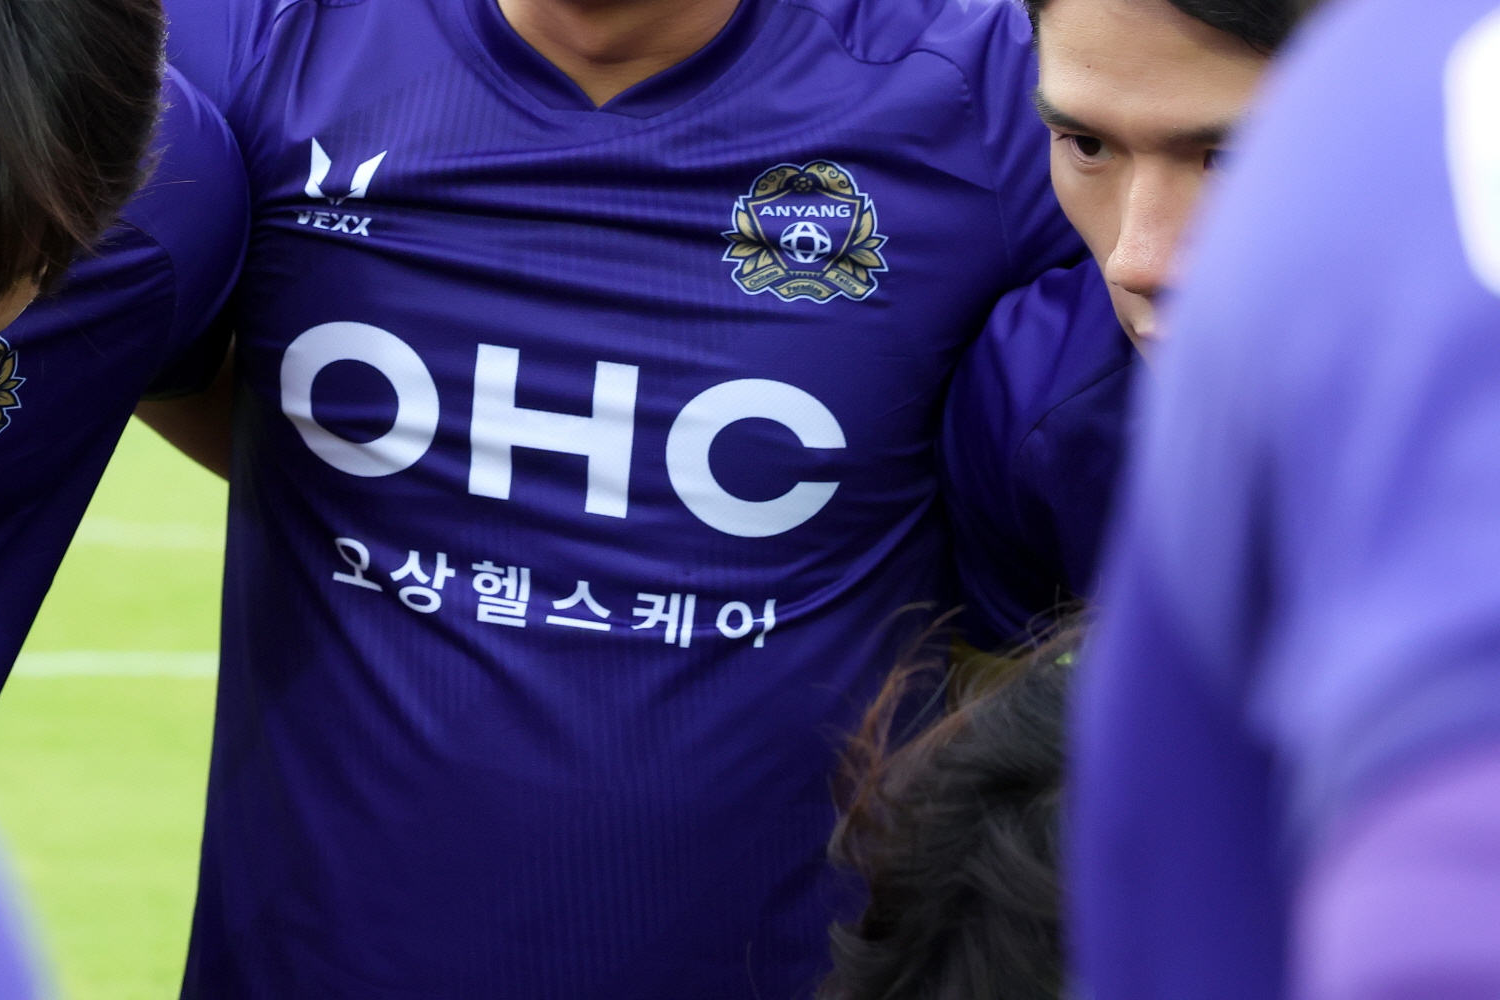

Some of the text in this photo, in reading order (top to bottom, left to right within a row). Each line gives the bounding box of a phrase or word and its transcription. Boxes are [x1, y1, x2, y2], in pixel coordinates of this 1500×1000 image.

[296, 210, 373, 237] VEXX
[758, 204, 851, 218] ANYANG
[280, 320, 847, 538] OHC
[331, 536, 778, 649] 오상헬스케어
